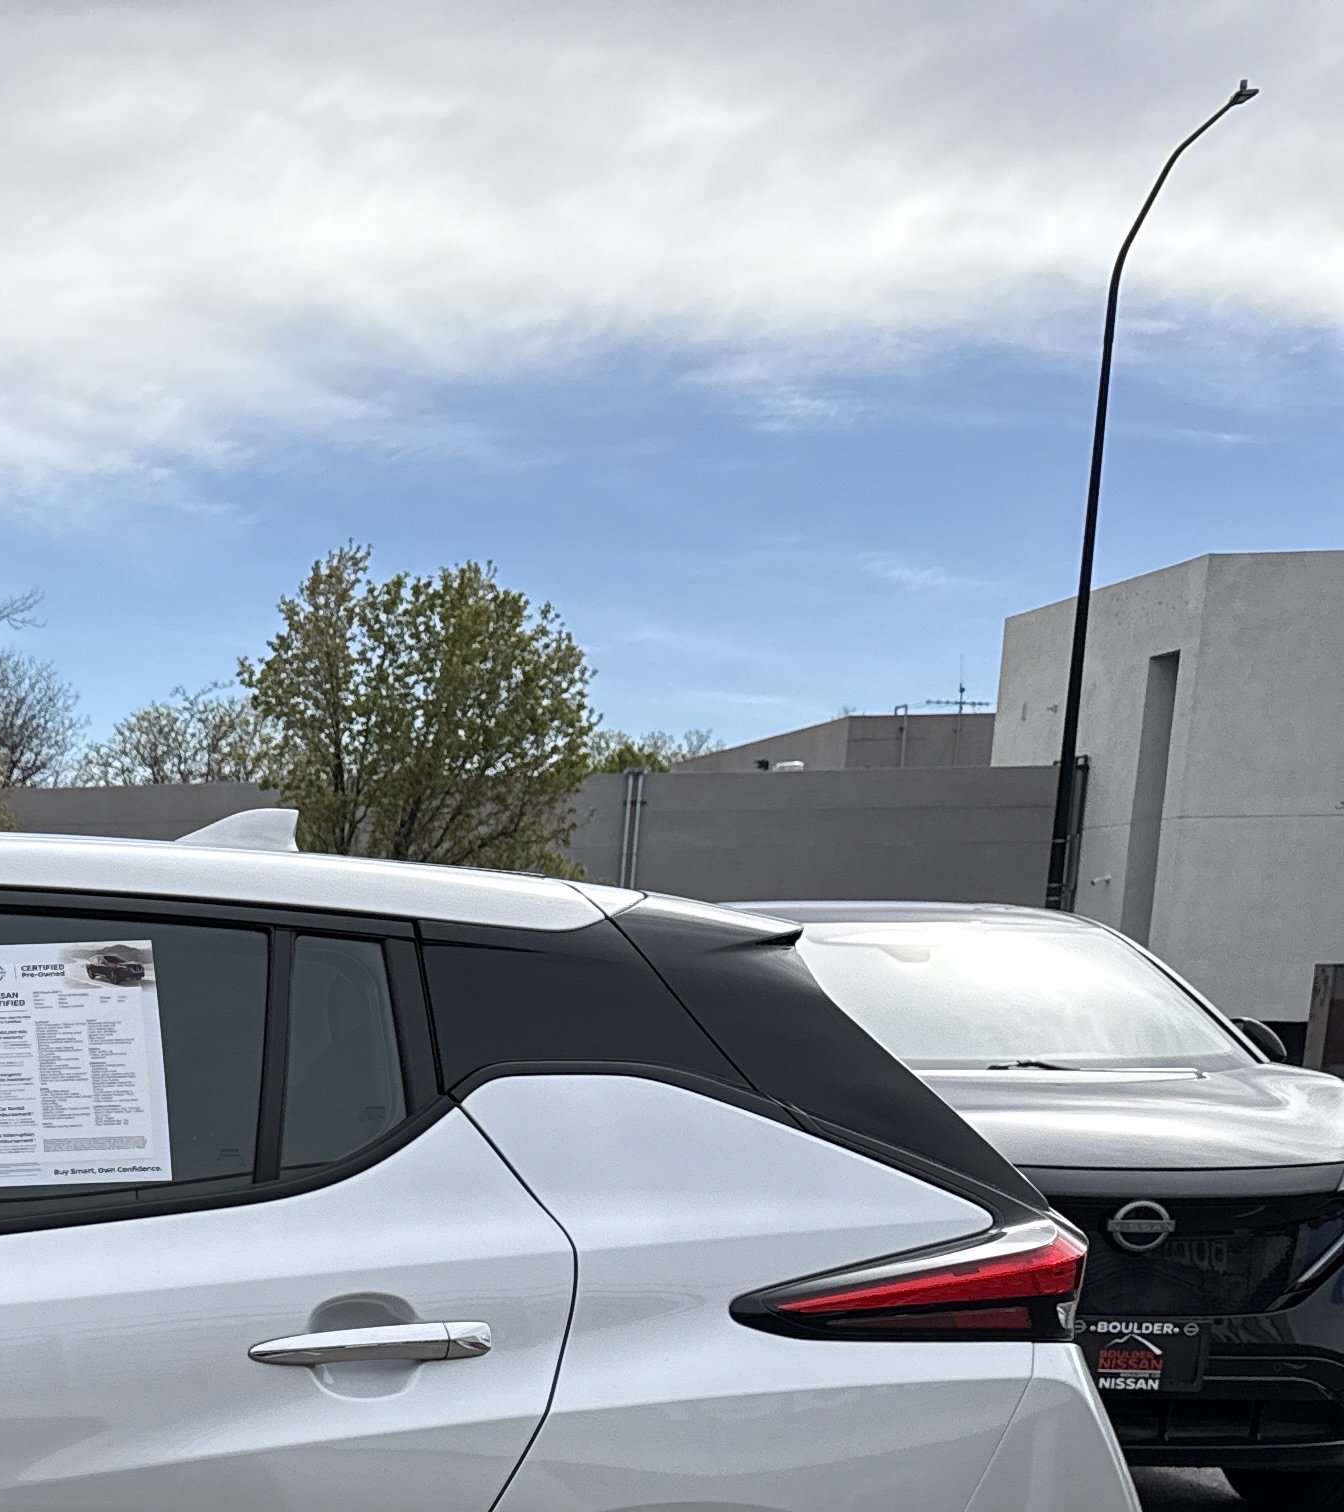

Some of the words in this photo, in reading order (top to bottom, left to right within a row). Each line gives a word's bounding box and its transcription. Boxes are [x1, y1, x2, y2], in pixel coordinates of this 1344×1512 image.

[20, 964, 65, 972] CERTIFIED
[53, 1168, 69, 1176] Buy
[1097, 1321, 1174, 1335] BOULDER
[1098, 1349, 1155, 1359] BOULDER
[1098, 1357, 1164, 1371] NISSAN
[1098, 1377, 1161, 1391] NISSAN
